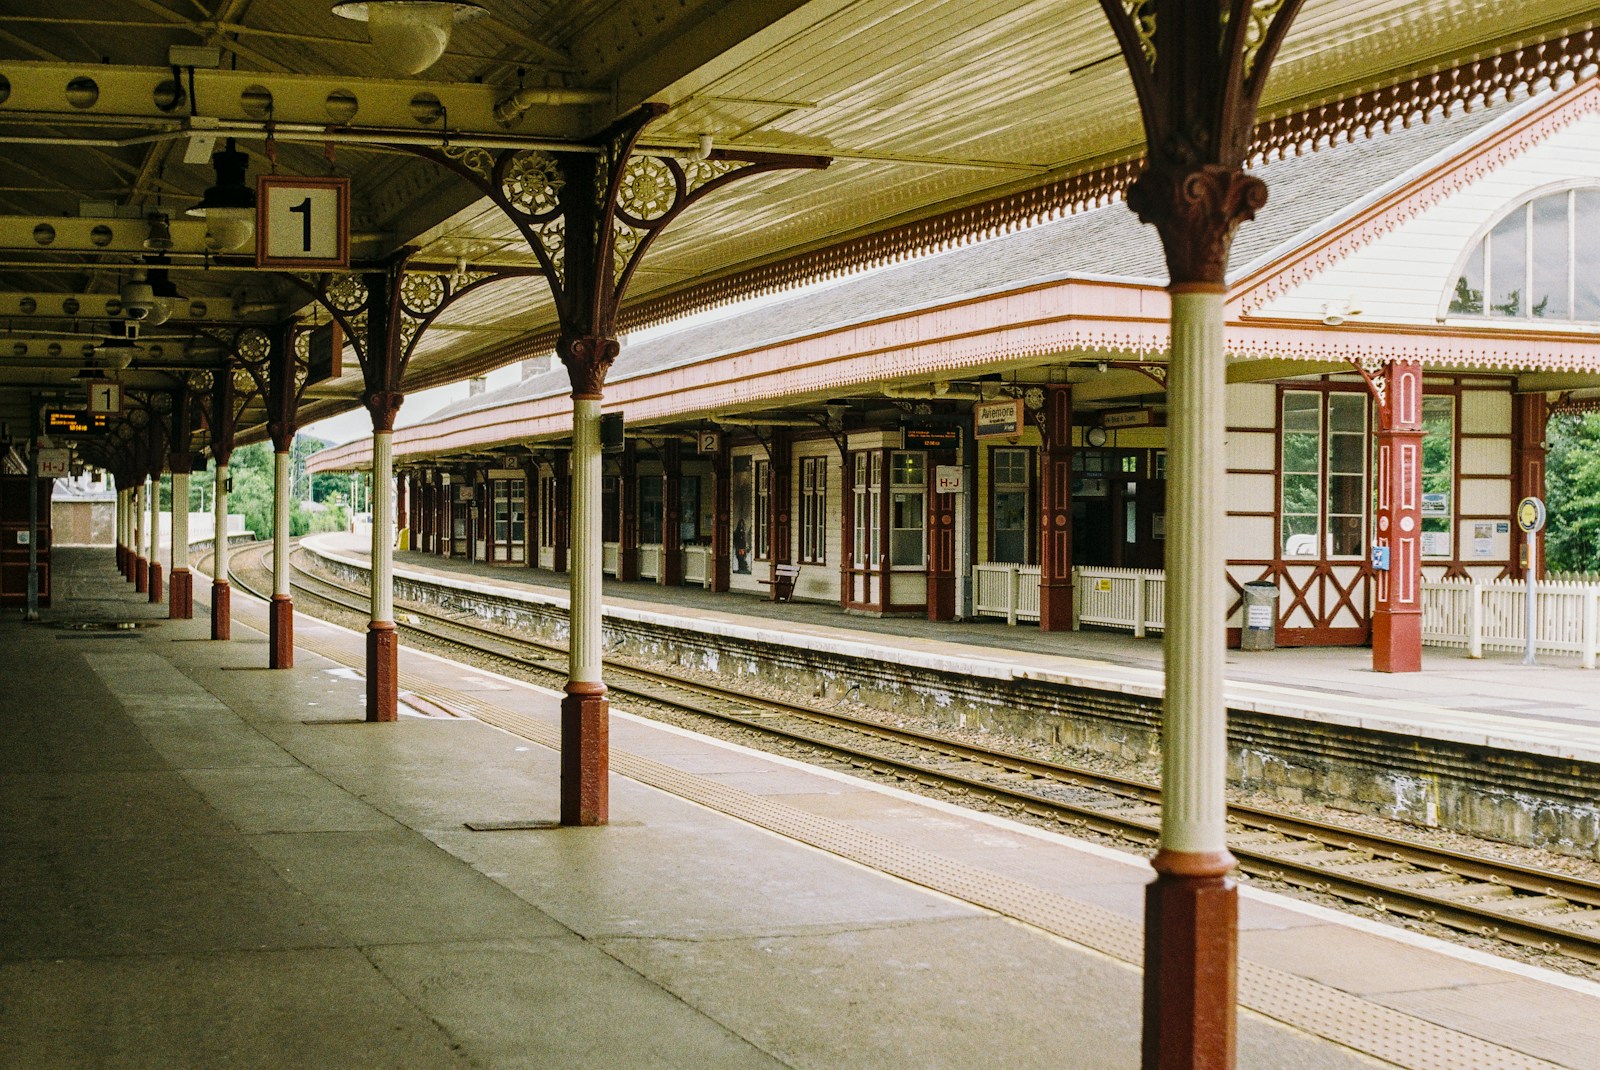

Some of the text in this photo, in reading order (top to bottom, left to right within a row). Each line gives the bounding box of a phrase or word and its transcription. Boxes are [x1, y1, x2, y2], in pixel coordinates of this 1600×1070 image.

[289, 197, 311, 252] 1
[101, 388, 111, 410] 1
[981, 407, 1015, 419] Aviemore
[704, 436, 715, 450] 2
[508, 458, 515, 468] 2
[940, 478, 960, 488] H-J
